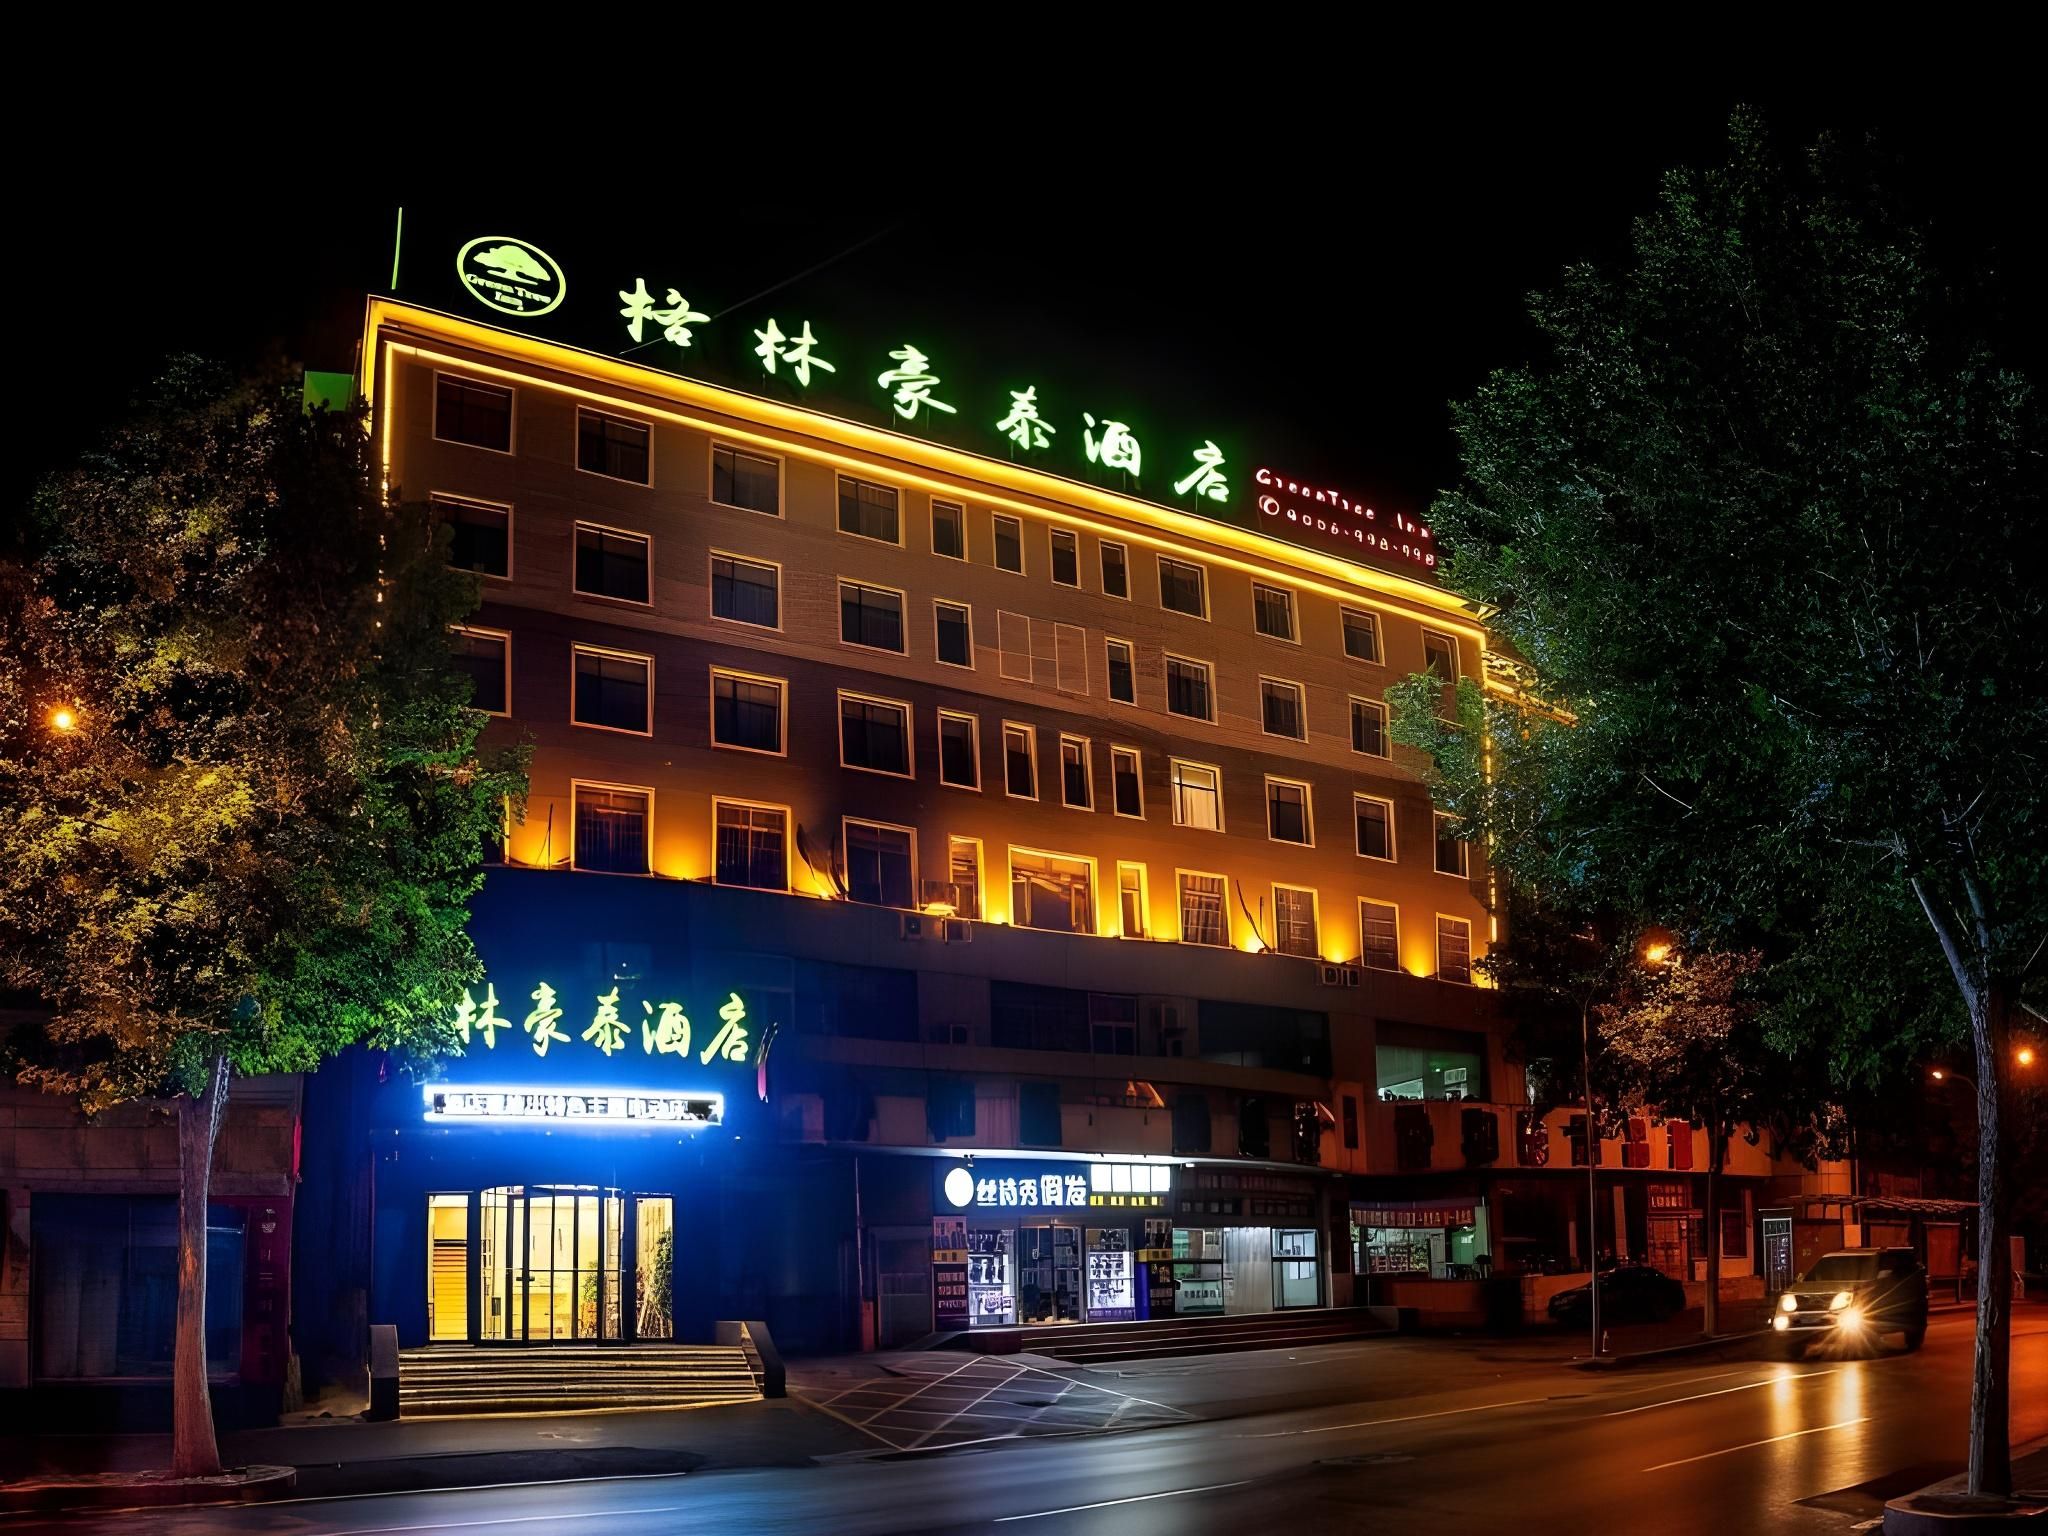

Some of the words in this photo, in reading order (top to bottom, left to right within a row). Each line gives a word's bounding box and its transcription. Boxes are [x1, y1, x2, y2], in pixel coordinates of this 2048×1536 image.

[619, 278, 1230, 503] 格林豪泰酒店
[1397, 513, 1430, 538] Inn
